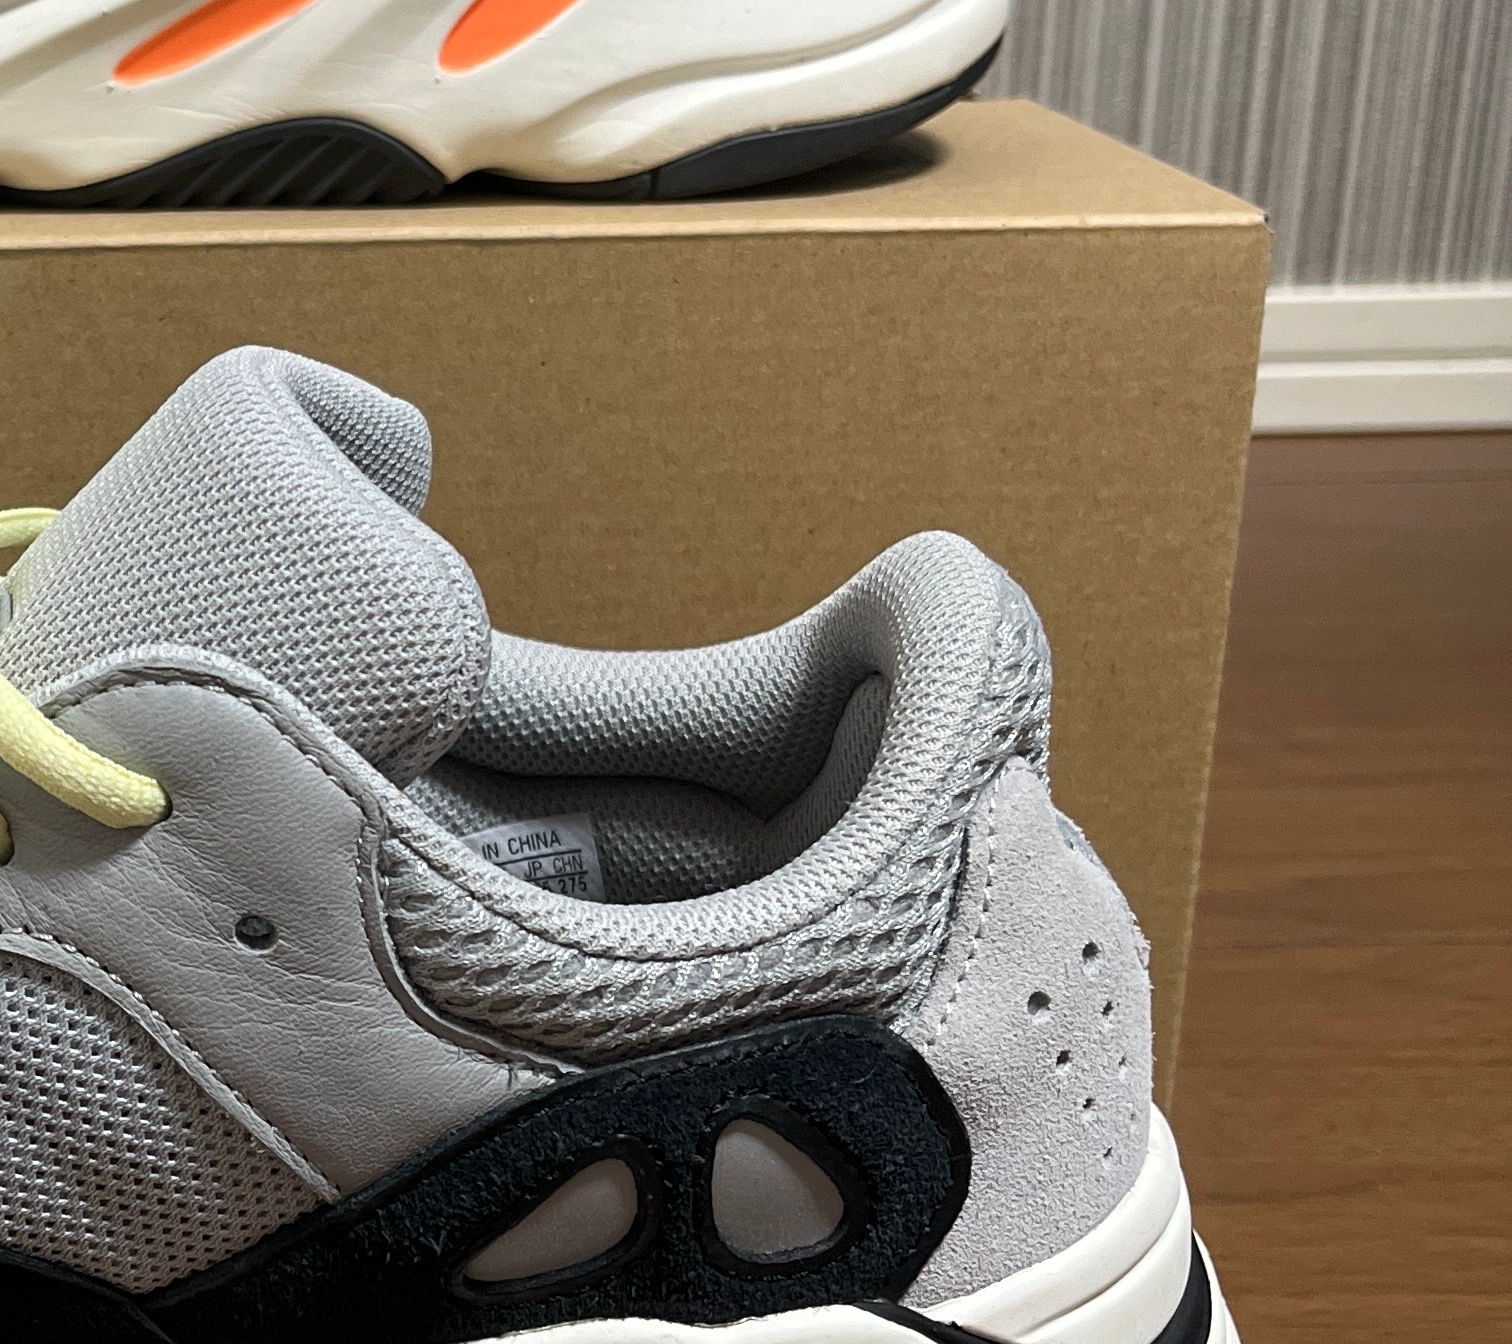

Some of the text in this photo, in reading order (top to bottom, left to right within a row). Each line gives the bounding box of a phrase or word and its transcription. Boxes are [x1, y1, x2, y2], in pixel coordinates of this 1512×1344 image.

[482, 830, 561, 860] IN CHINA
[524, 854, 583, 878] JP CHN
[557, 875, 587, 894] 275
